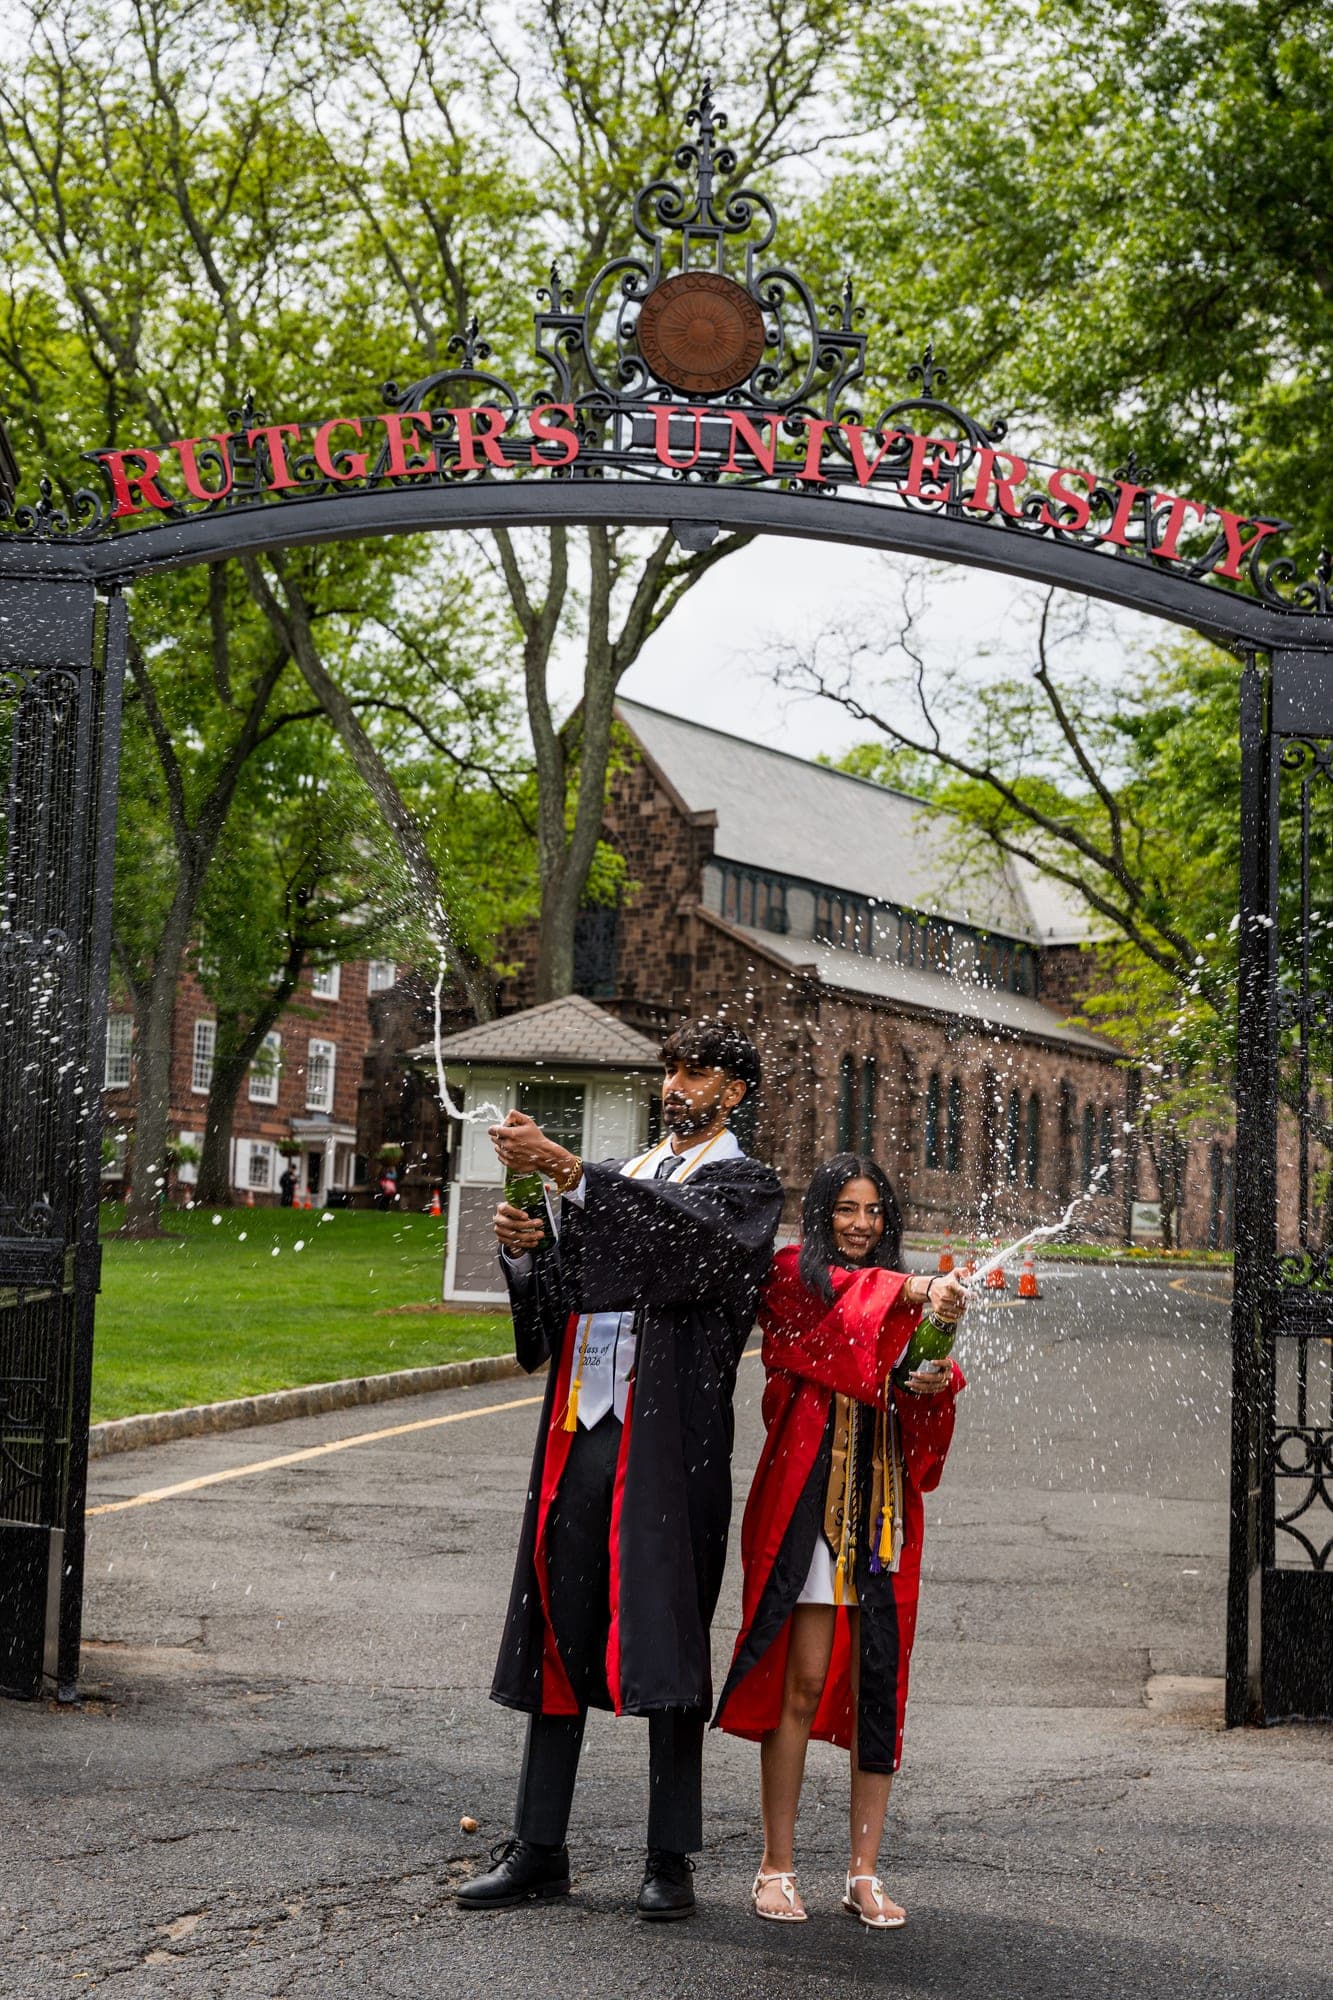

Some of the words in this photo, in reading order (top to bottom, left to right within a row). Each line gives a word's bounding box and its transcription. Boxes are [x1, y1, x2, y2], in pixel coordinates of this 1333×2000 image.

[100, 403, 581, 518] RUTGERS
[647, 405, 1279, 581] UNIVERSITY
[601, 1343, 612, 1356] of
